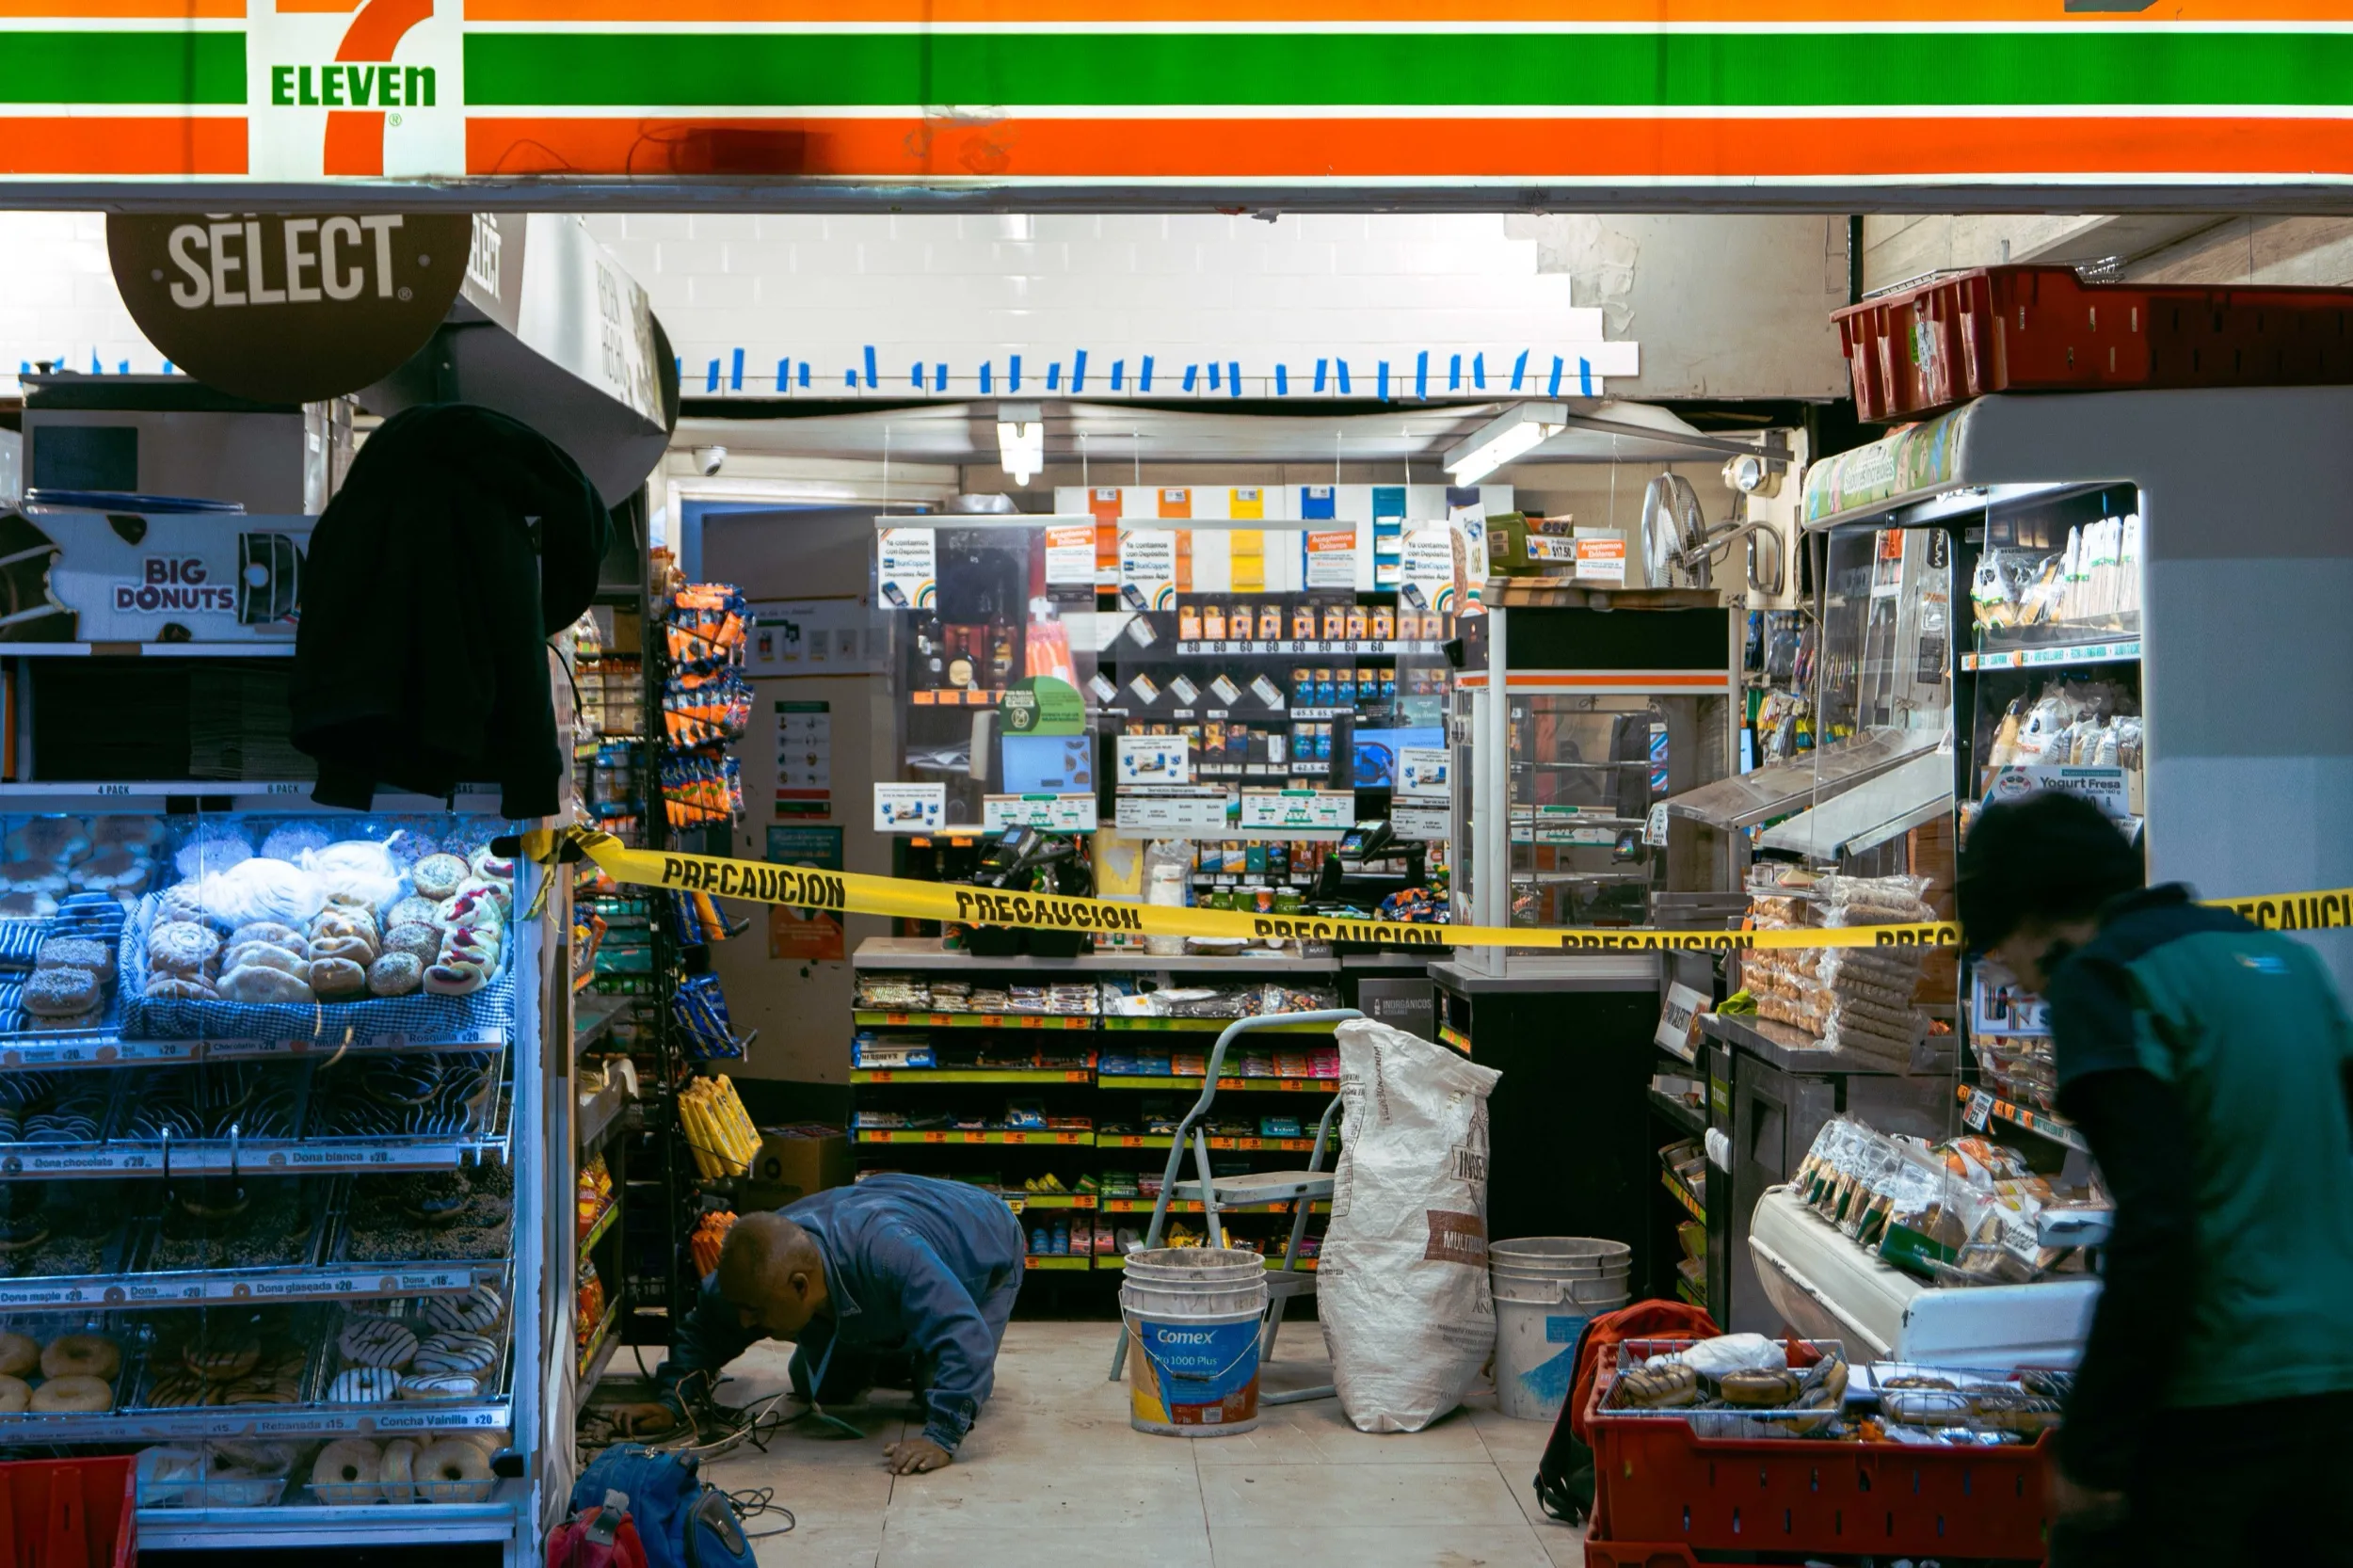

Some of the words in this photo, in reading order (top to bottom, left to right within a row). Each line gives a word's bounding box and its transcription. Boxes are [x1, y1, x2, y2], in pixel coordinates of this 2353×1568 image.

[276, 0, 434, 176] 7
[168, 214, 404, 311] SELECT
[145, 559, 207, 585] BIG
[117, 585, 234, 610] DONUTS
[1187, 642, 1200, 652] 60
[1213, 642, 1226, 652] 60
[1240, 642, 1253, 652] 60
[1266, 642, 1279, 652] 60
[1292, 642, 1305, 652] 60
[1319, 642, 1332, 652] 60
[1345, 642, 1357, 652] 60
[1370, 642, 1384, 652] 60
[97, 784, 104, 794] 4
[105, 783, 129, 794] PACK
[276, 782, 299, 793] PACK
[2040, 776, 2086, 791] Yogurt
[2089, 778, 2121, 789] Fresa
[662, 856, 846, 908] PRECAUCION
[956, 890, 1142, 930] PRECAUCION
[1255, 919, 1443, 945] PRECAUCION
[1383, 999, 1432, 1009] INORGÁNICOS
[408, 1032, 457, 1045] Rosquilla
[461, 1032, 479, 1042] $20
[258, 1040, 277, 1051] $20
[293, 1152, 323, 1162] Dona
[325, 1151, 363, 1162] blanca
[370, 1152, 388, 1162] $20
[257, 1283, 283, 1293] Dona
[285, 1282, 332, 1294] glaseada
[335, 1280, 352, 1291] $20
[402, 1276, 425, 1286] Dona
[0, 1291, 27, 1302] Dona
[29, 1291, 61, 1303] maple
[65, 1290, 83, 1302] $20
[130, 1286, 158, 1295] Dona
[183, 1287, 200, 1298] $20
[1157, 1328, 1217, 1345] Comex
[1155, 1353, 1170, 1366] Pro
[1171, 1355, 1195, 1366] 1000
[1196, 1355, 1218, 1367] Plus
[262, 1421, 322, 1431] Rebanada
[326, 1418, 344, 1430] $15
[380, 1416, 424, 1427] Concha
[425, 1415, 468, 1426] Vainilla
[474, 1415, 493, 1425] $20
